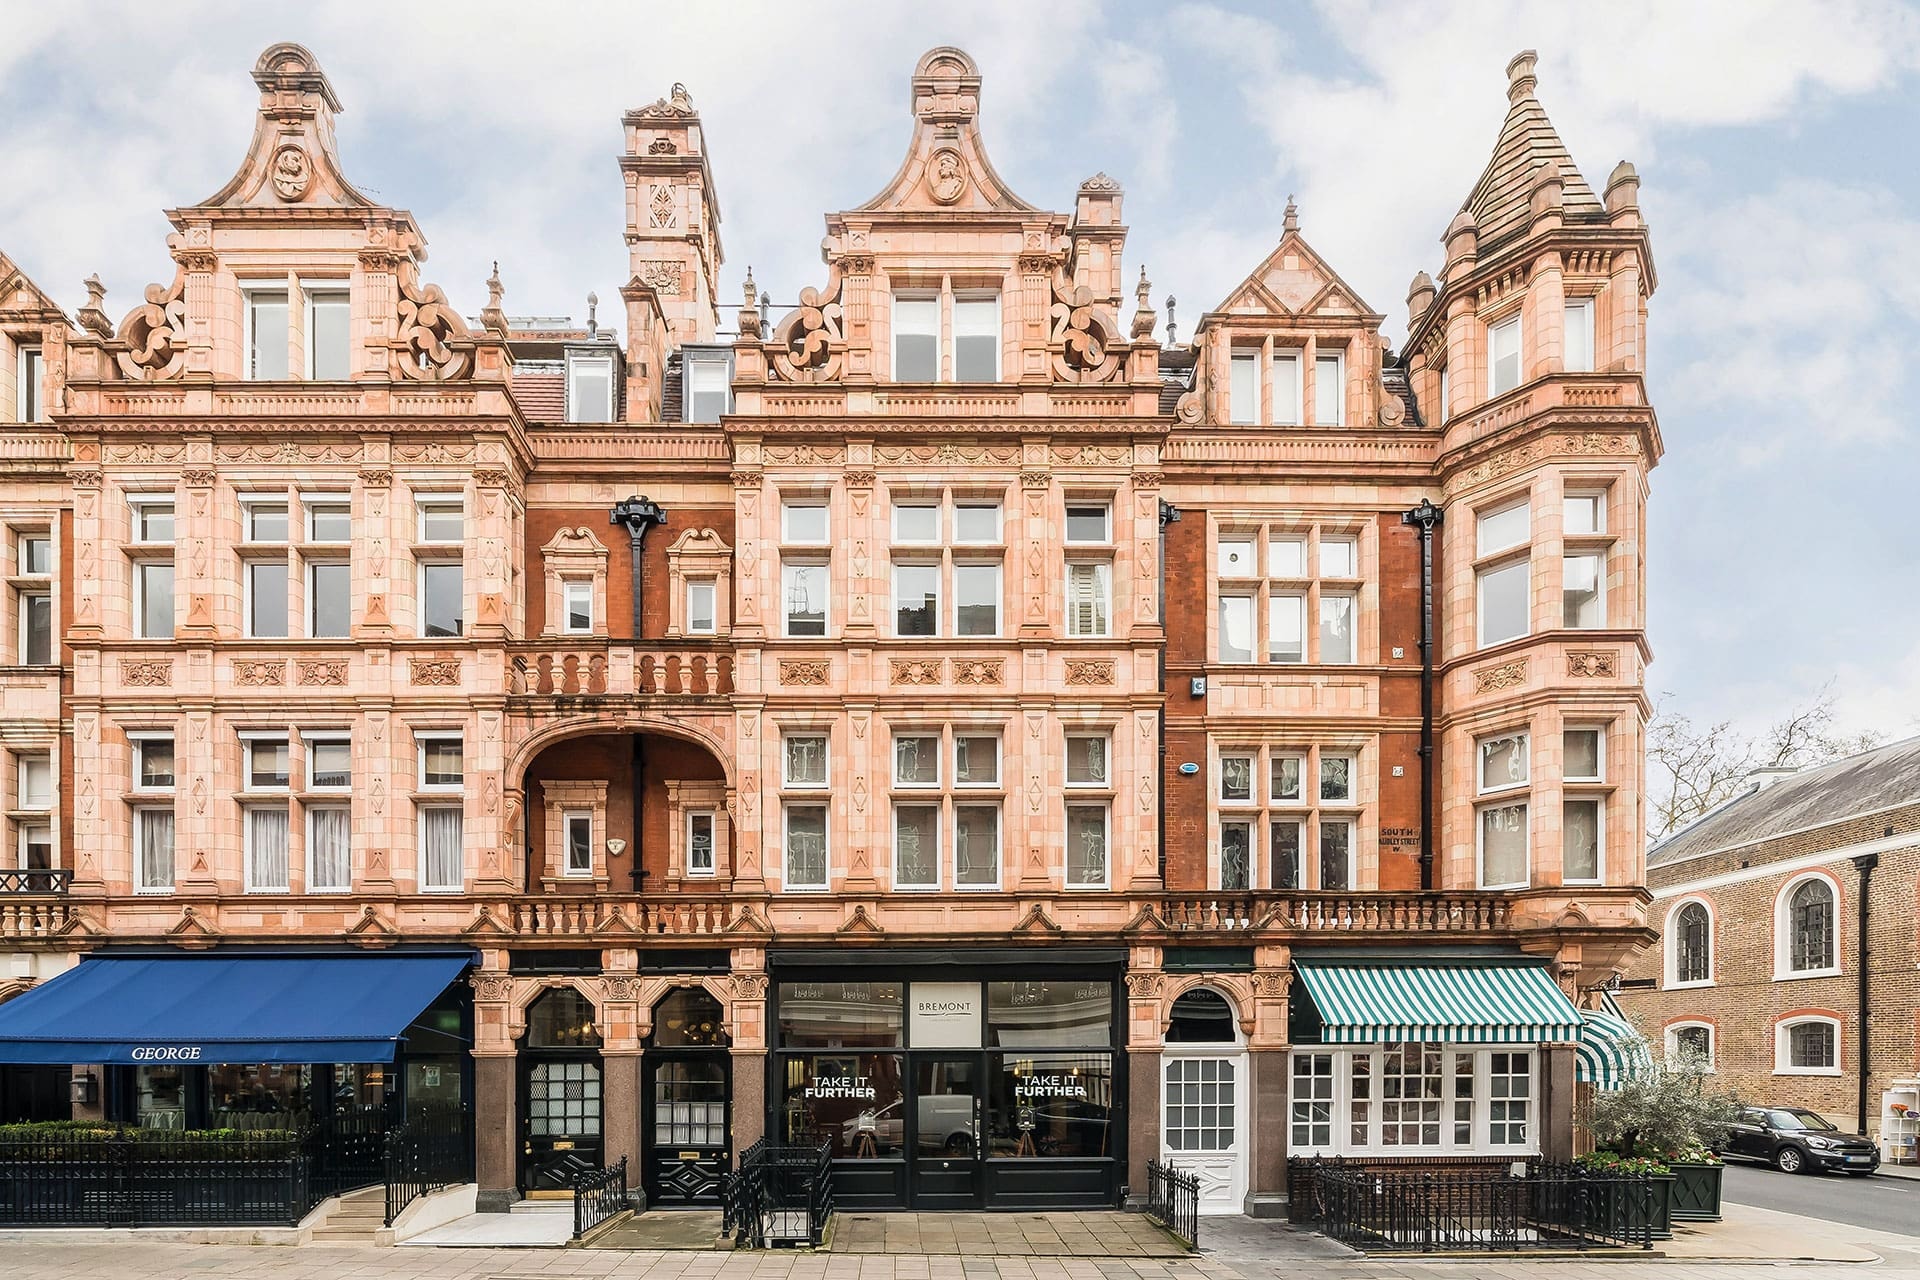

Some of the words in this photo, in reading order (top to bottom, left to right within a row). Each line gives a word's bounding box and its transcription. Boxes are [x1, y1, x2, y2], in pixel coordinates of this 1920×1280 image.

[1381, 828, 1413, 836] SOUTH
[1400, 837, 1419, 846] STREET
[918, 1002, 971, 1011] BREMONT
[131, 1047, 201, 1060] GEORGE
[812, 1076, 851, 1087] TAKE
[855, 1076, 868, 1087] IT
[1022, 1075, 1060, 1086] TAKE
[1064, 1075, 1077, 1086] IT
[805, 1087, 876, 1098] FURTHER
[1015, 1086, 1084, 1097] FURTHER
